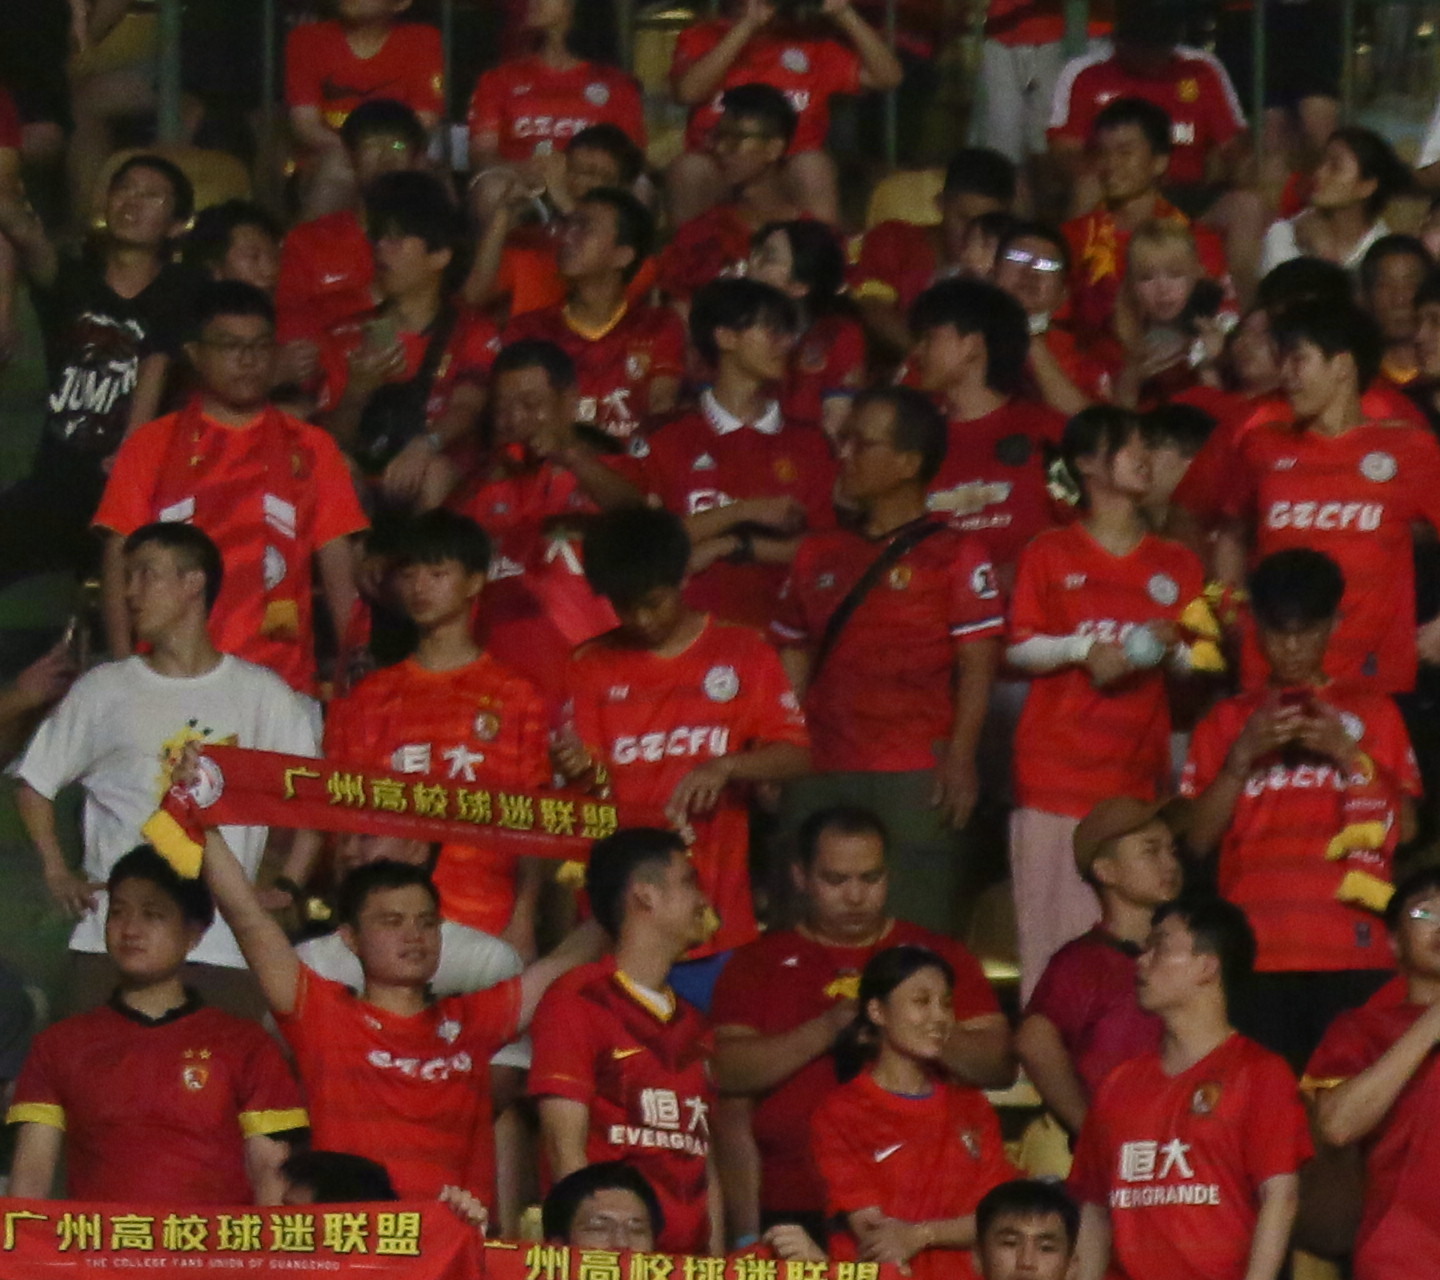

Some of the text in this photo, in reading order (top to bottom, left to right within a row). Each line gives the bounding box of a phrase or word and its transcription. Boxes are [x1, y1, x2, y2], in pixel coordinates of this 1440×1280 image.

[1268, 501, 1383, 532] GZCFU
[613, 727, 730, 765] GZCFU
[285, 766, 618, 840] 广州高校球迷联盟
[642, 1088, 710, 1133] 恒大
[1120, 1138, 1194, 1182] 恒大
[3, 1211, 421, 1257] 广州高校球迷联盟
[86, 1258, 341, 1270] THE COLLEGE FANS UNION OF GUANGZHOU
